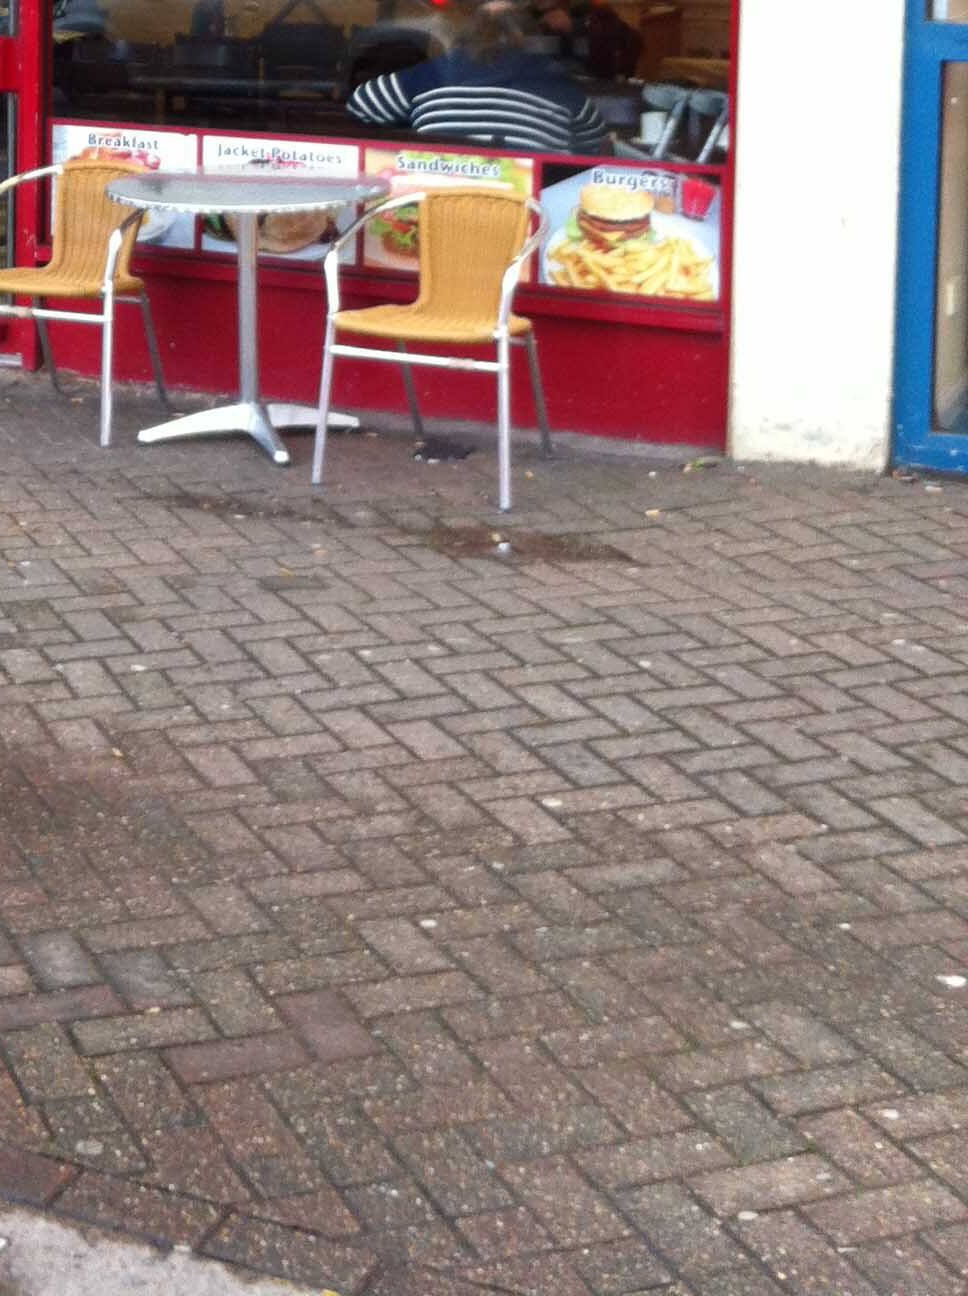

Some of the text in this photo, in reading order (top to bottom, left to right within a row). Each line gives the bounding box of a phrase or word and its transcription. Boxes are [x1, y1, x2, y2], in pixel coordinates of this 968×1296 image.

[88, 132, 159, 151] Breakfast
[218, 144, 342, 164] Jacket Potatoes
[397, 155, 501, 176] Sandwiches
[592, 170, 669, 191] Burgers
